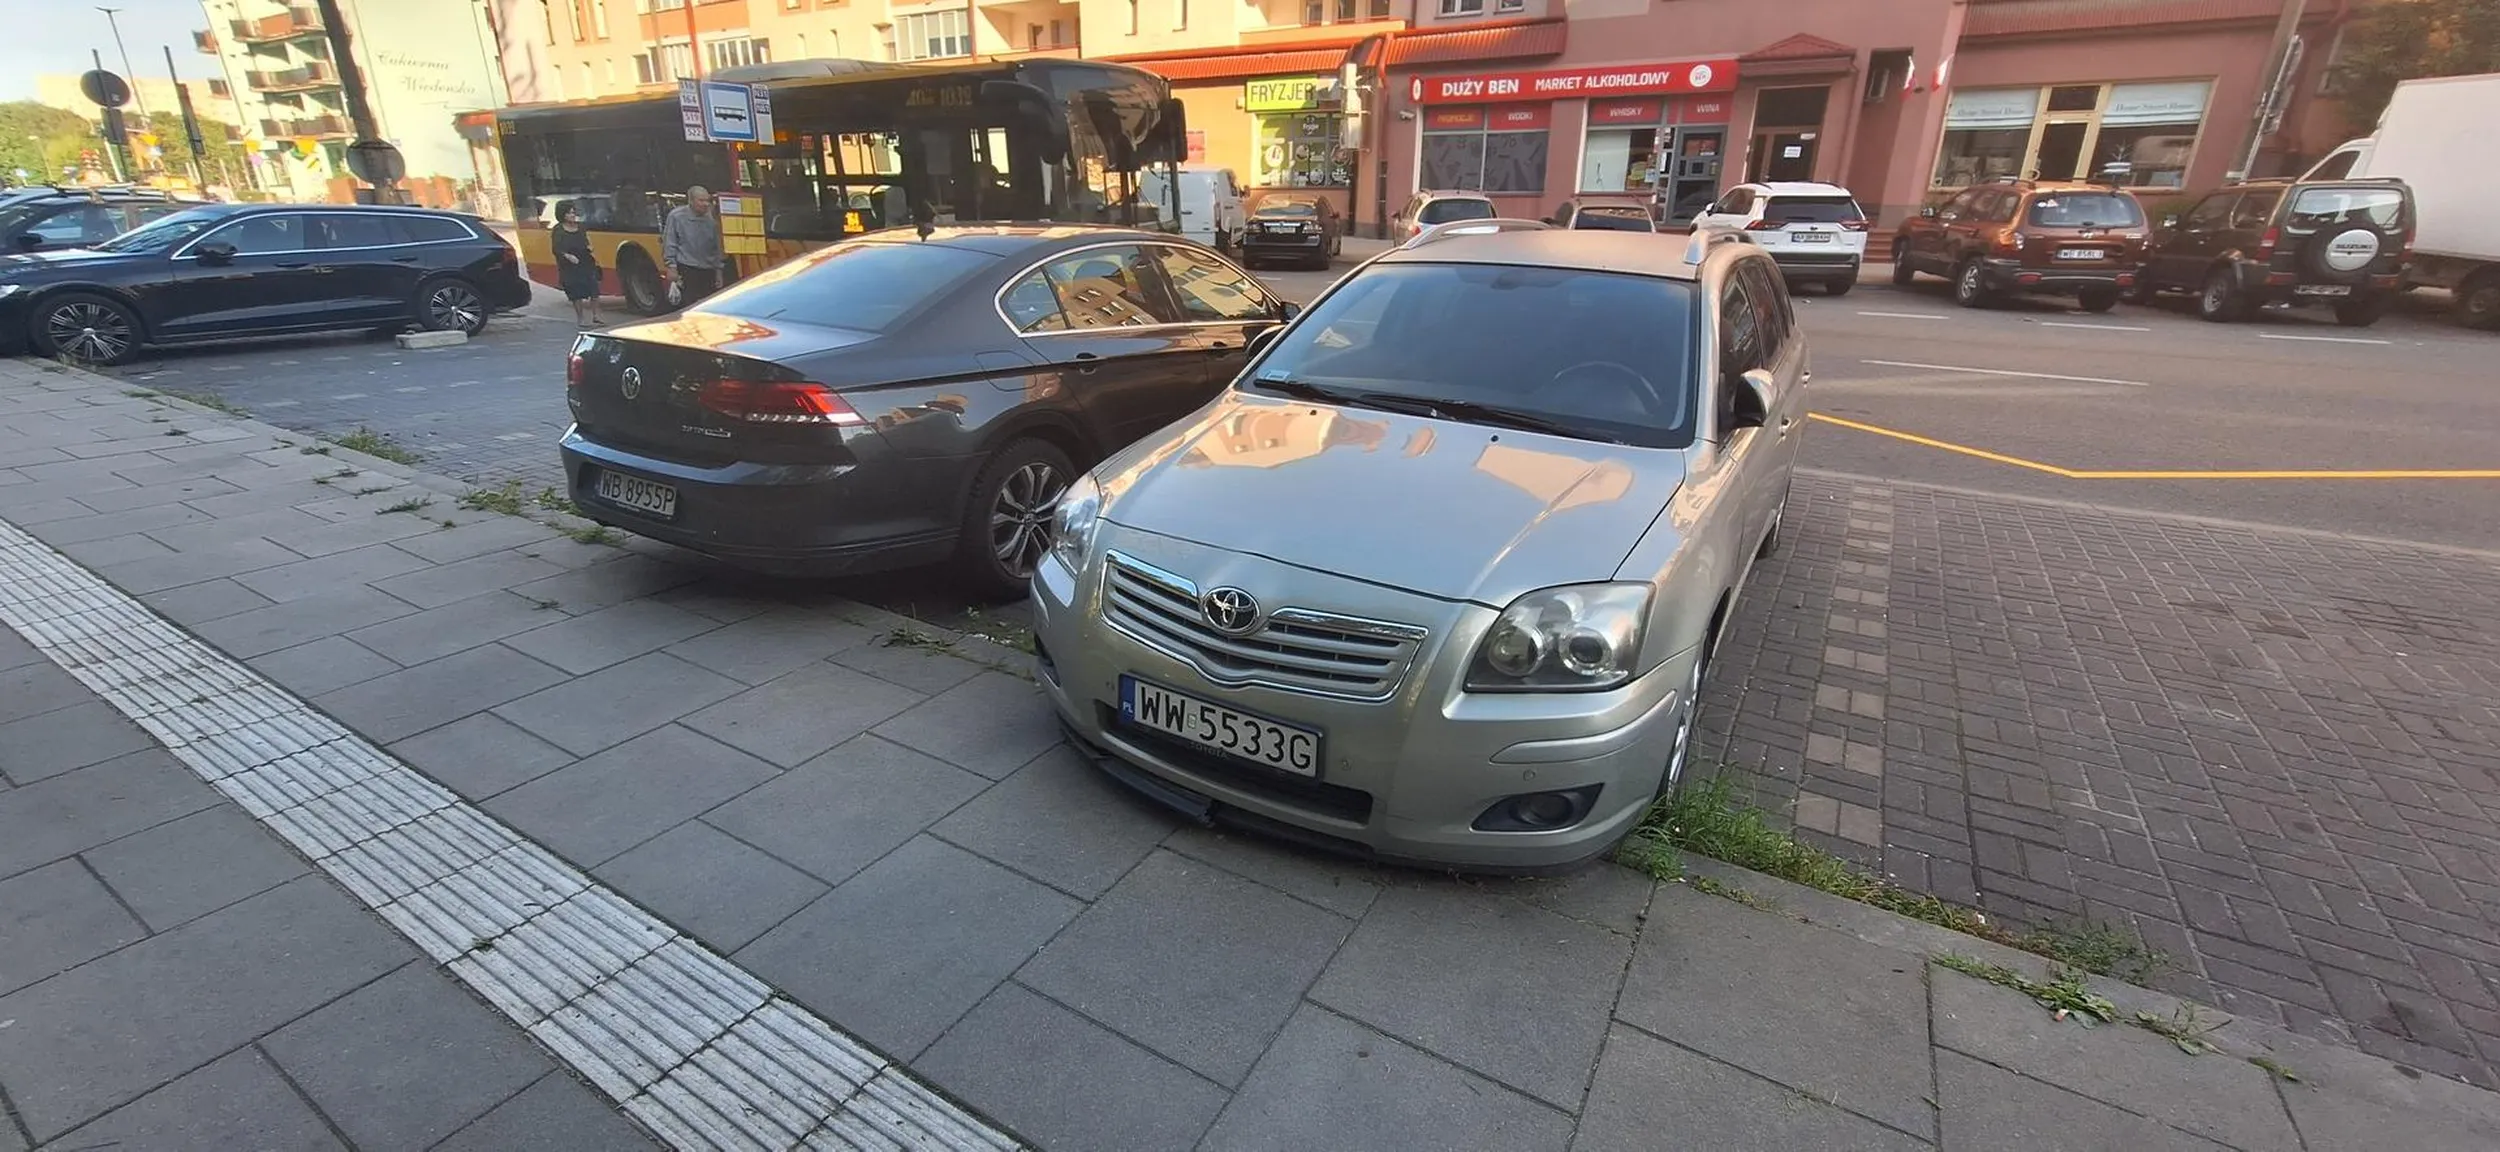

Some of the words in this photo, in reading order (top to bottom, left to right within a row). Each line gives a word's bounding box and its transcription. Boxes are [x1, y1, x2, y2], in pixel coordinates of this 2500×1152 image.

[1442, 79, 1484, 97] DUŻY
[1488, 79, 1520, 95] BEN
[1535, 76, 1583, 91] MARKET
[1585, 72, 1670, 89] ALKOHOLOWY
[682, 92, 697, 104] 164
[1250, 83, 1314, 102] FRYZJER
[1610, 107, 1643, 117] WHISKY
[1697, 104, 1720, 113] WINA
[687, 128, 702, 137] 522
[601, 471, 621, 498] WB
[625, 478, 676, 512] 8955P
[1122, 701, 1134, 713] PL
[1140, 686, 1186, 733] WW
[1199, 705, 1311, 769] 5533G
